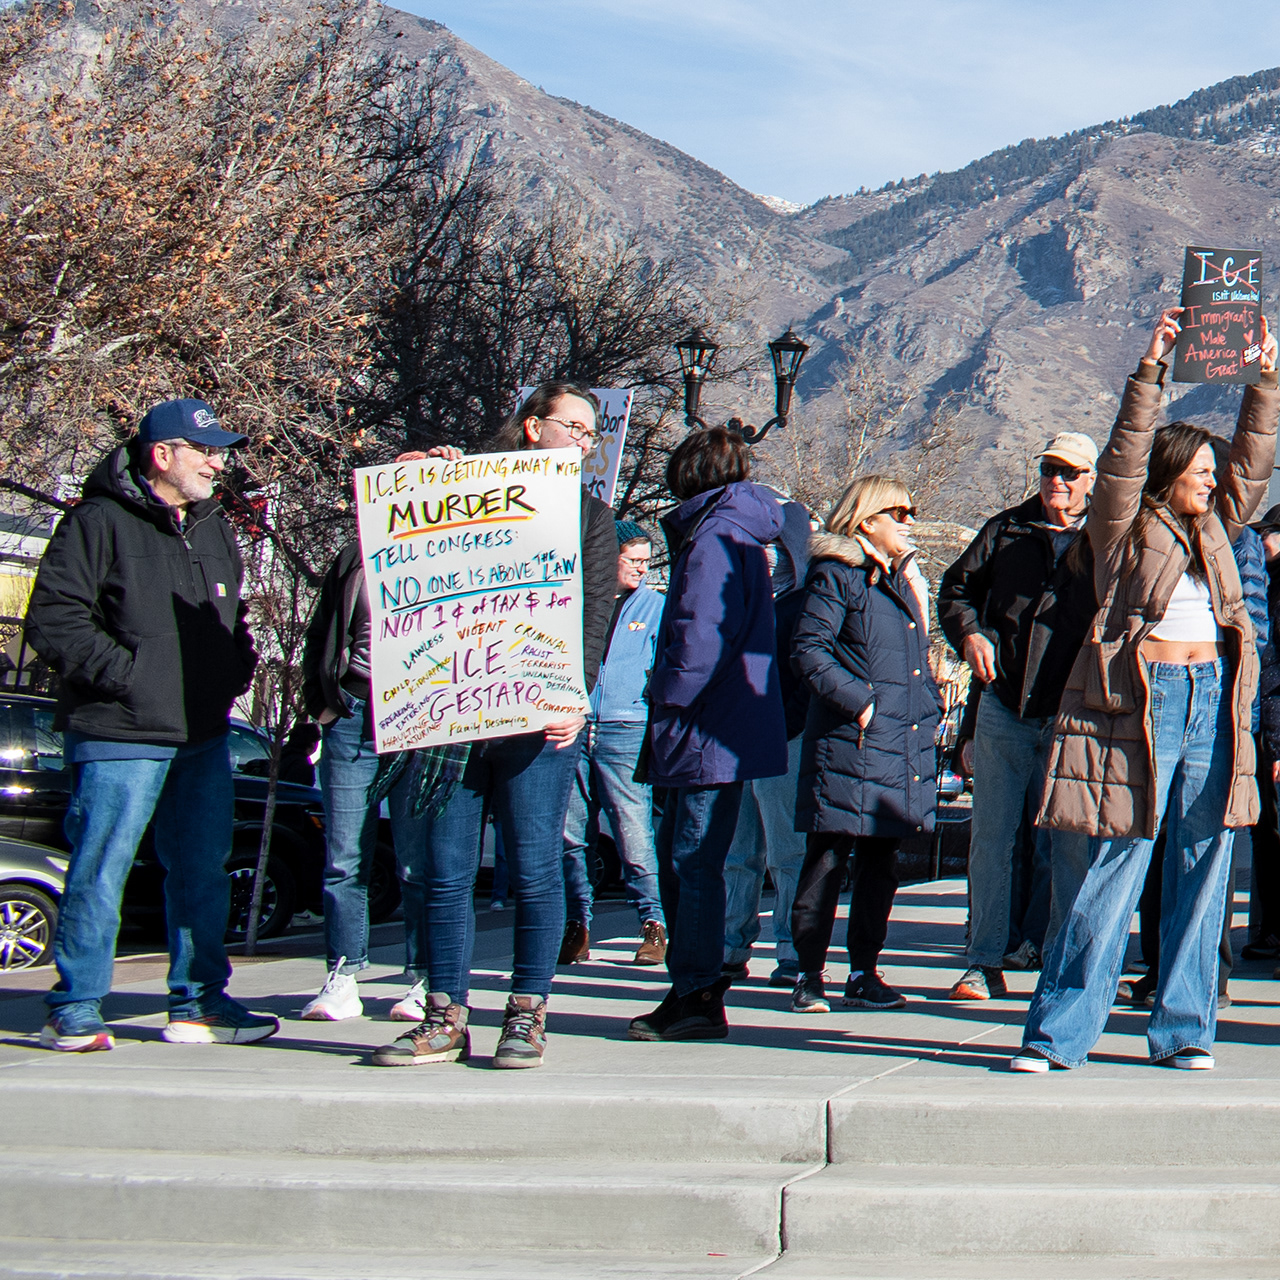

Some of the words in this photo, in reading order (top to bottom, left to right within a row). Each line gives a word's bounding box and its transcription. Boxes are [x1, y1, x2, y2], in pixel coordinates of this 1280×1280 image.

[1185, 305, 1254, 332] Immigrants
[1184, 343, 1238, 363] America
[364, 465, 414, 504] I.C.E.
[420, 467, 437, 486] IS
[441, 458, 508, 484] GETTING
[512, 456, 551, 477] AWAY
[556, 461, 581, 477] WITH
[388, 485, 539, 535] MURDER
[369, 539, 419, 573] TELL
[532, 548, 557, 566] THE
[541, 553, 577, 581] LAW
[427, 571, 464, 594] ONE
[468, 567, 486, 585] IS
[489, 560, 535, 585] ABOVE
[380, 576, 422, 610] NO
[379, 605, 429, 642] NOT
[472, 598, 487, 615] of
[490, 591, 520, 613] TAX
[525, 587, 540, 617] $
[545, 590, 572, 609] for
[402, 633, 445, 670] LAWLESS
[513, 622, 569, 654] CRIMINAL
[521, 644, 554, 659] RACIST
[408, 656, 452, 696] KIDNAPPING
[452, 640, 506, 684] I.C.E.
[522, 671, 572, 683] UNLAWFULLY
[546, 681, 587, 700] DETAINING
[379, 701, 416, 730] BREAKING
[395, 695, 431, 731] ENTERING
[430, 681, 542, 722] GESTAPO
[535, 699, 586, 715] COWARDLY
[382, 719, 430, 749] ASSAULTING
[449, 721, 481, 736] Family
